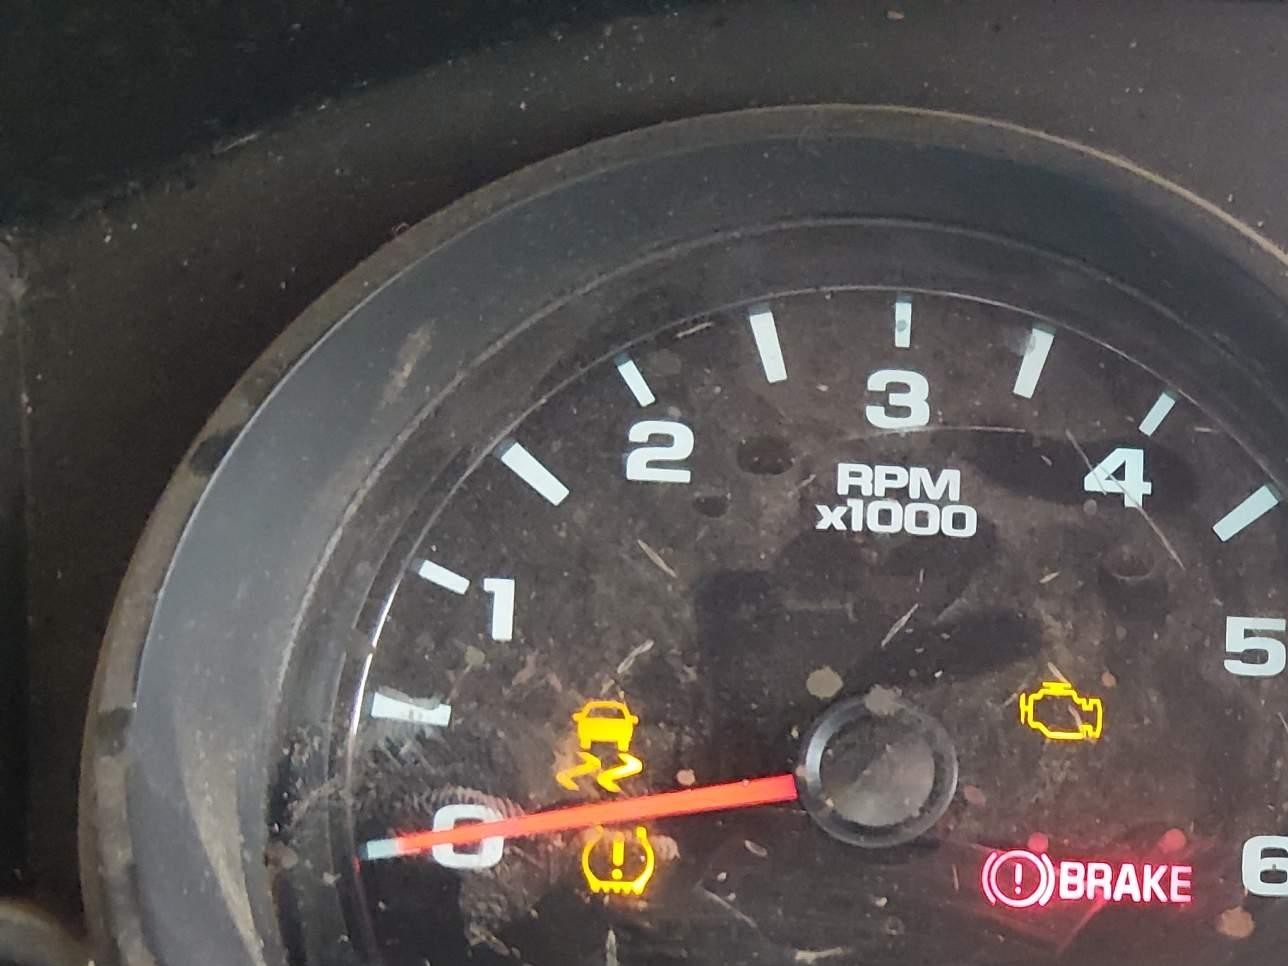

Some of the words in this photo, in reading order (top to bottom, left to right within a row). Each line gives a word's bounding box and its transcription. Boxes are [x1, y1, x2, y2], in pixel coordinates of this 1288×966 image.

[865, 370, 931, 430] 3
[626, 420, 695, 483] 2
[1084, 448, 1151, 507] 4
[836, 463, 961, 501] RPM
[815, 500, 978, 538] x1000
[483, 578, 515, 640] 1
[1223, 616, 1287, 677] 5
[432, 804, 505, 871] 0
[1058, 862, 1193, 904] BRAKE
